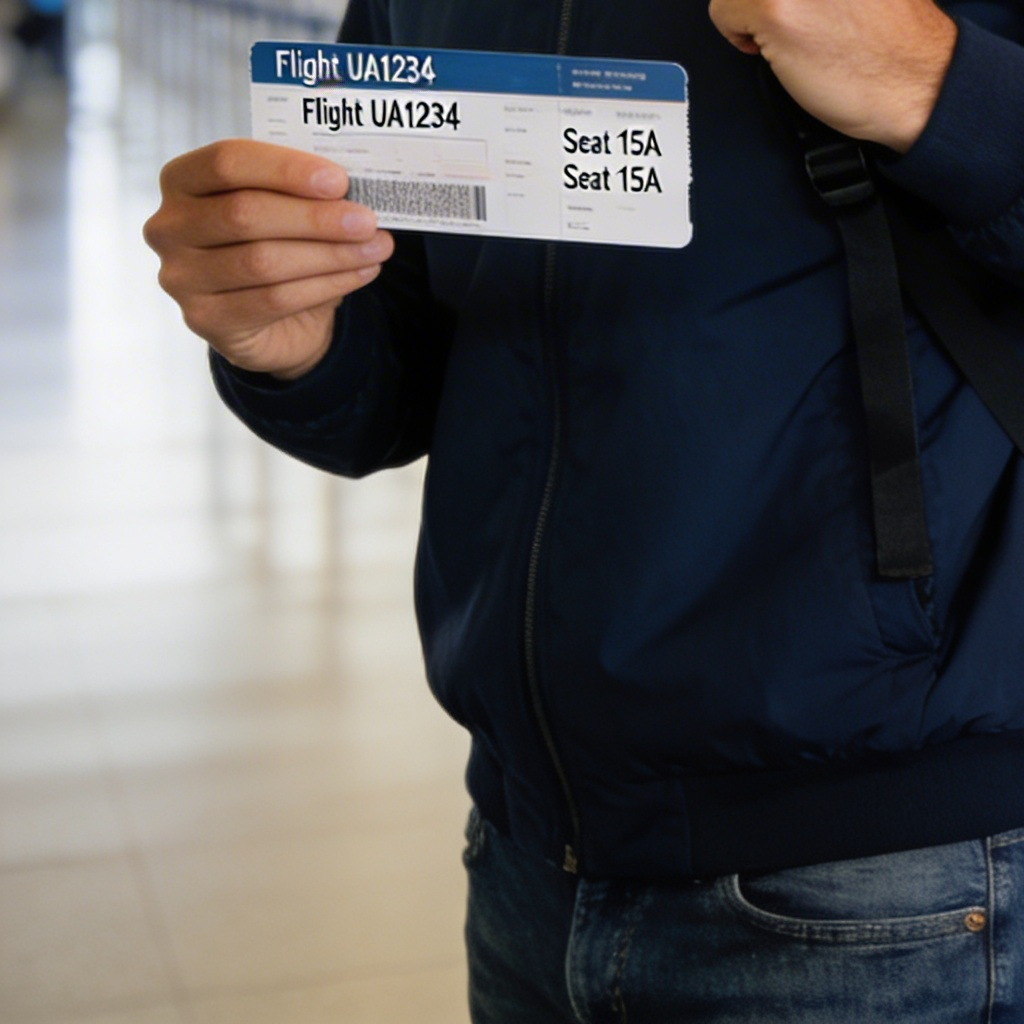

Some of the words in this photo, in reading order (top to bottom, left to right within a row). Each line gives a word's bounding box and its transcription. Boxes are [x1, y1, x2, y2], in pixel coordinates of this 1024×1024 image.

[276, 49, 341, 86] Flight
[347, 52, 436, 86] UA1234
[302, 97, 364, 131] Flight
[371, 99, 461, 131] UA1234
[563, 127, 611, 155] Seat
[617, 129, 662, 157] 15A
[563, 163, 611, 191] Seat
[617, 165, 662, 194] 15A
